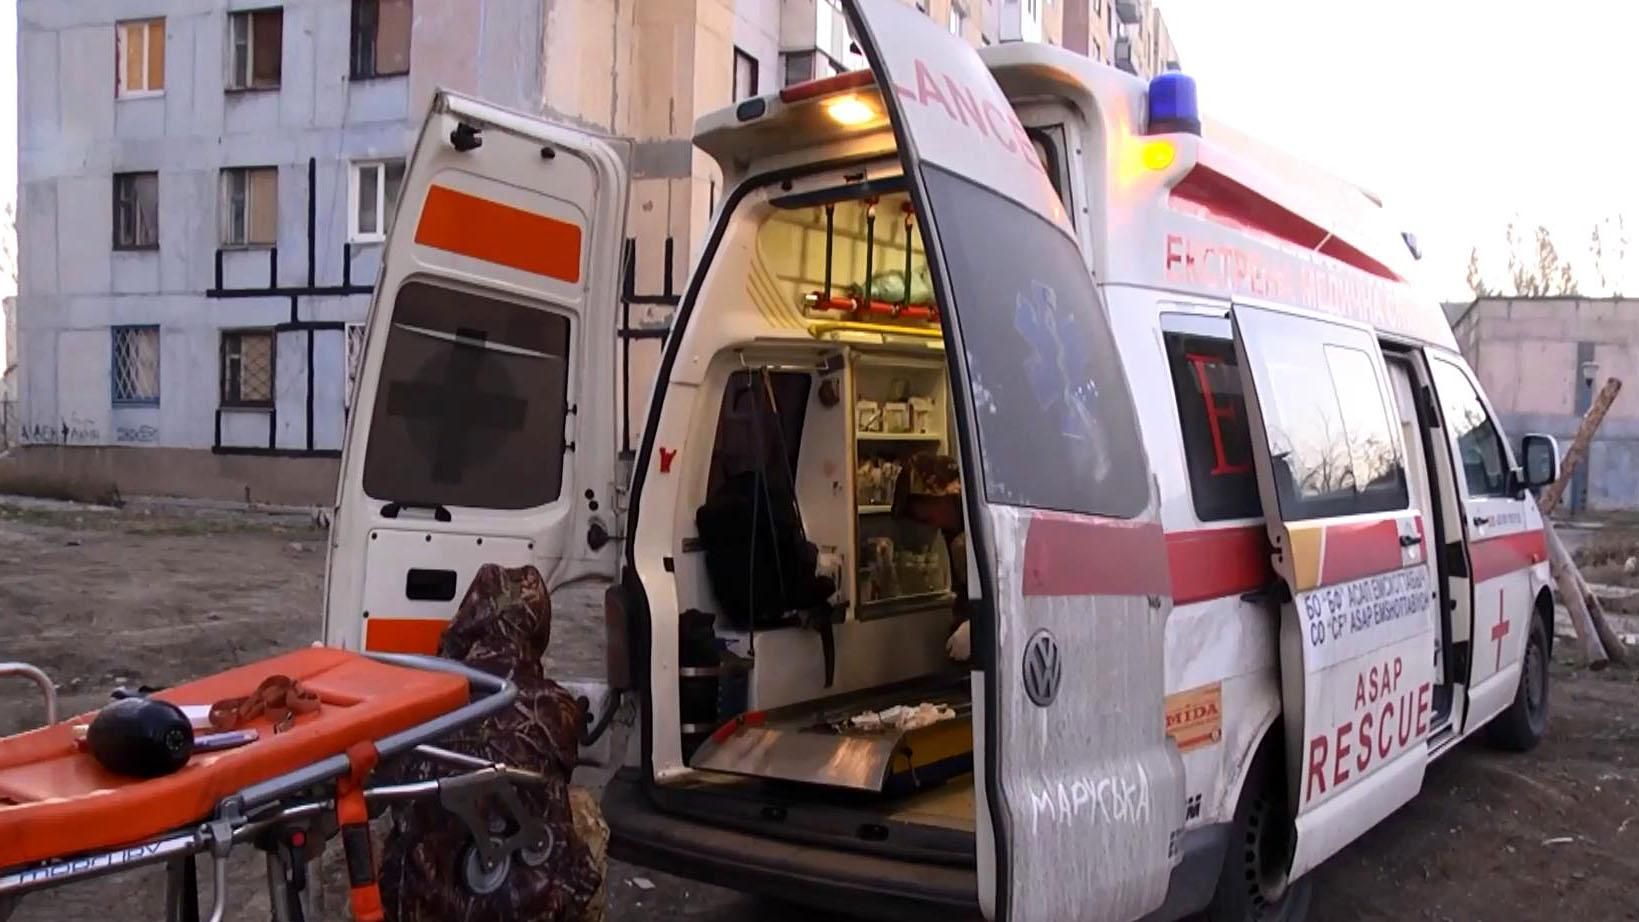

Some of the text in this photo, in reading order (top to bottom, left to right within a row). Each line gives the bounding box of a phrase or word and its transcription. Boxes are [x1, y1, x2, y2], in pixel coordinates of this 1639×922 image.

[1166, 234, 1290, 298] ЕКСТРЕН
[1355, 656, 1402, 710] ASAP
[1306, 682, 1430, 802] RESCUE
